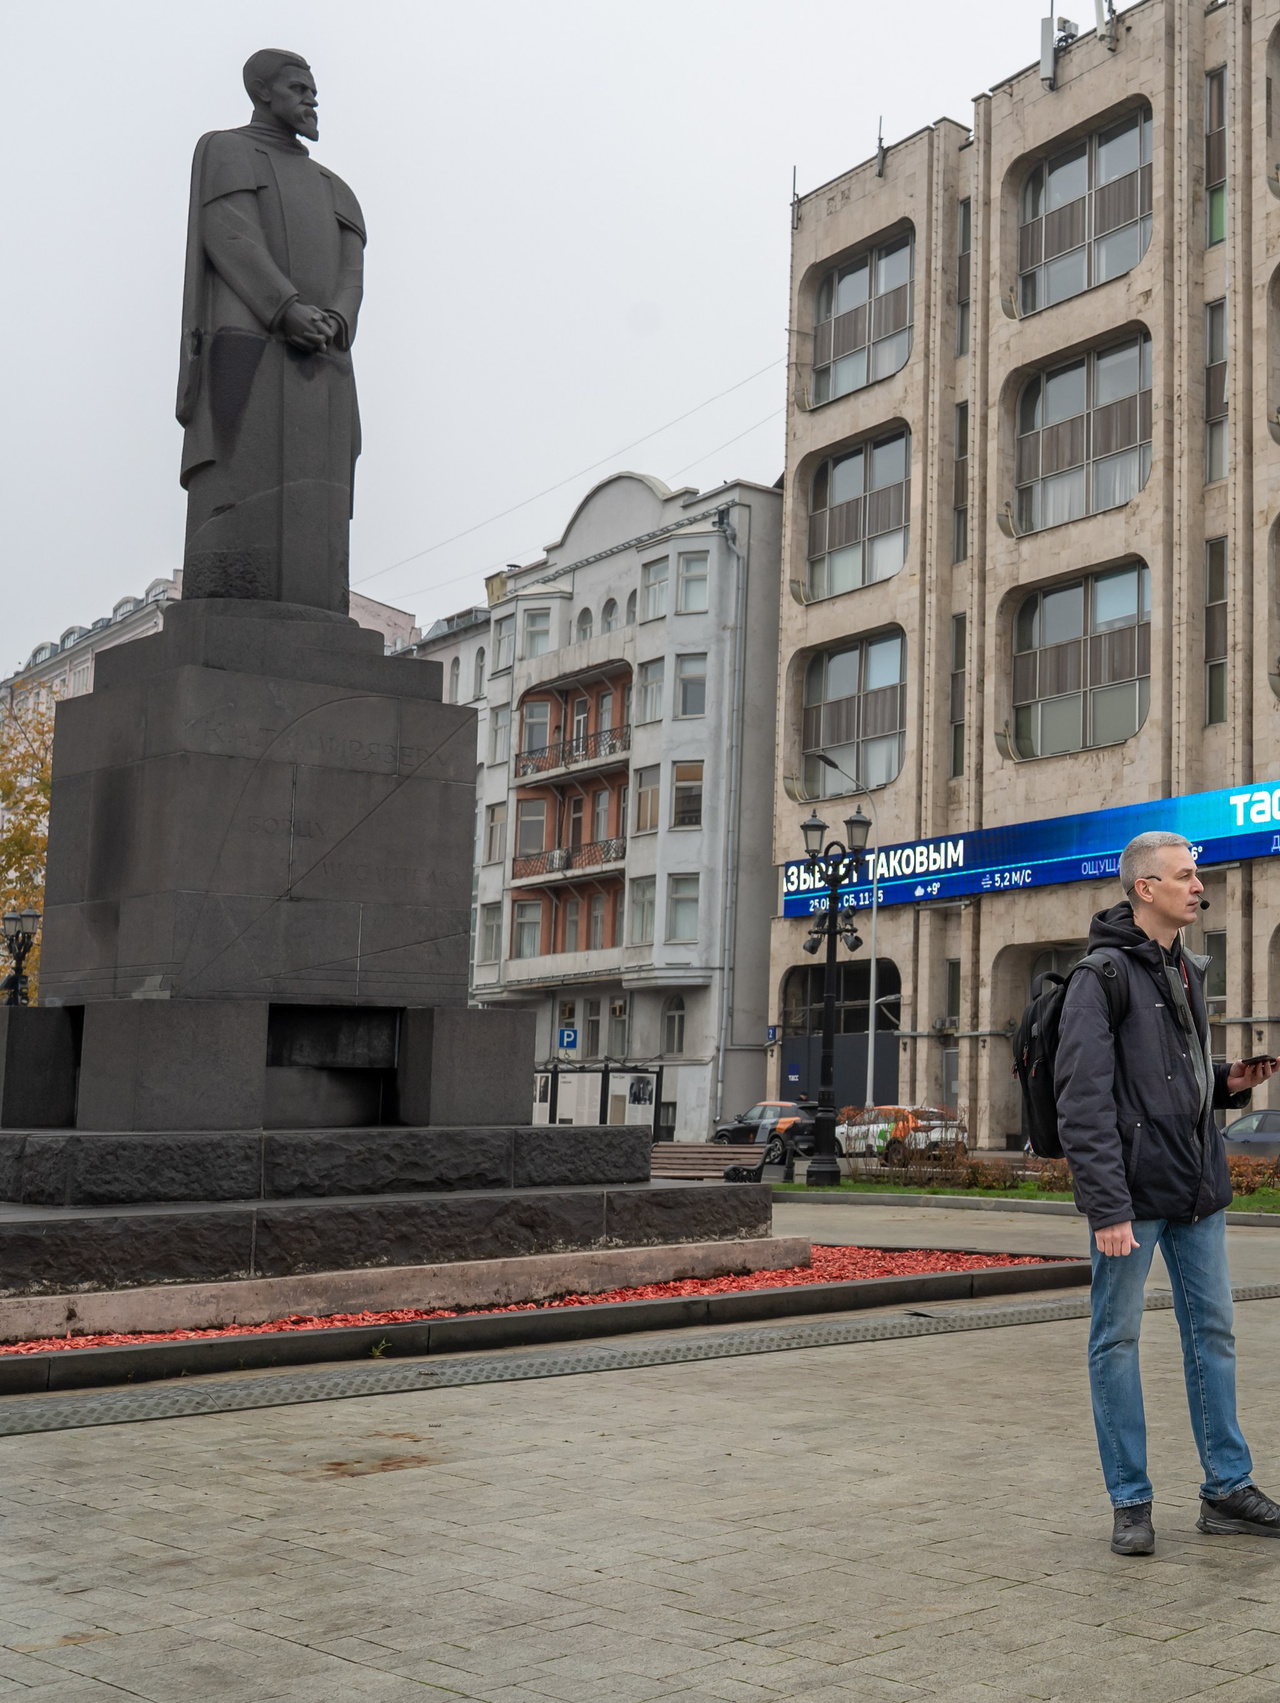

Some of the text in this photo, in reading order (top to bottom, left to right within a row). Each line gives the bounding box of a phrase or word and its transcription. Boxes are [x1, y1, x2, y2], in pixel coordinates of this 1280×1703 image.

[865, 840, 964, 880] ТАКОВЫМ
[995, 870, 1032, 888] 5,2 М/С
[859, 890, 883, 905] 11:5
[767, 1029, 773, 1039] 2
